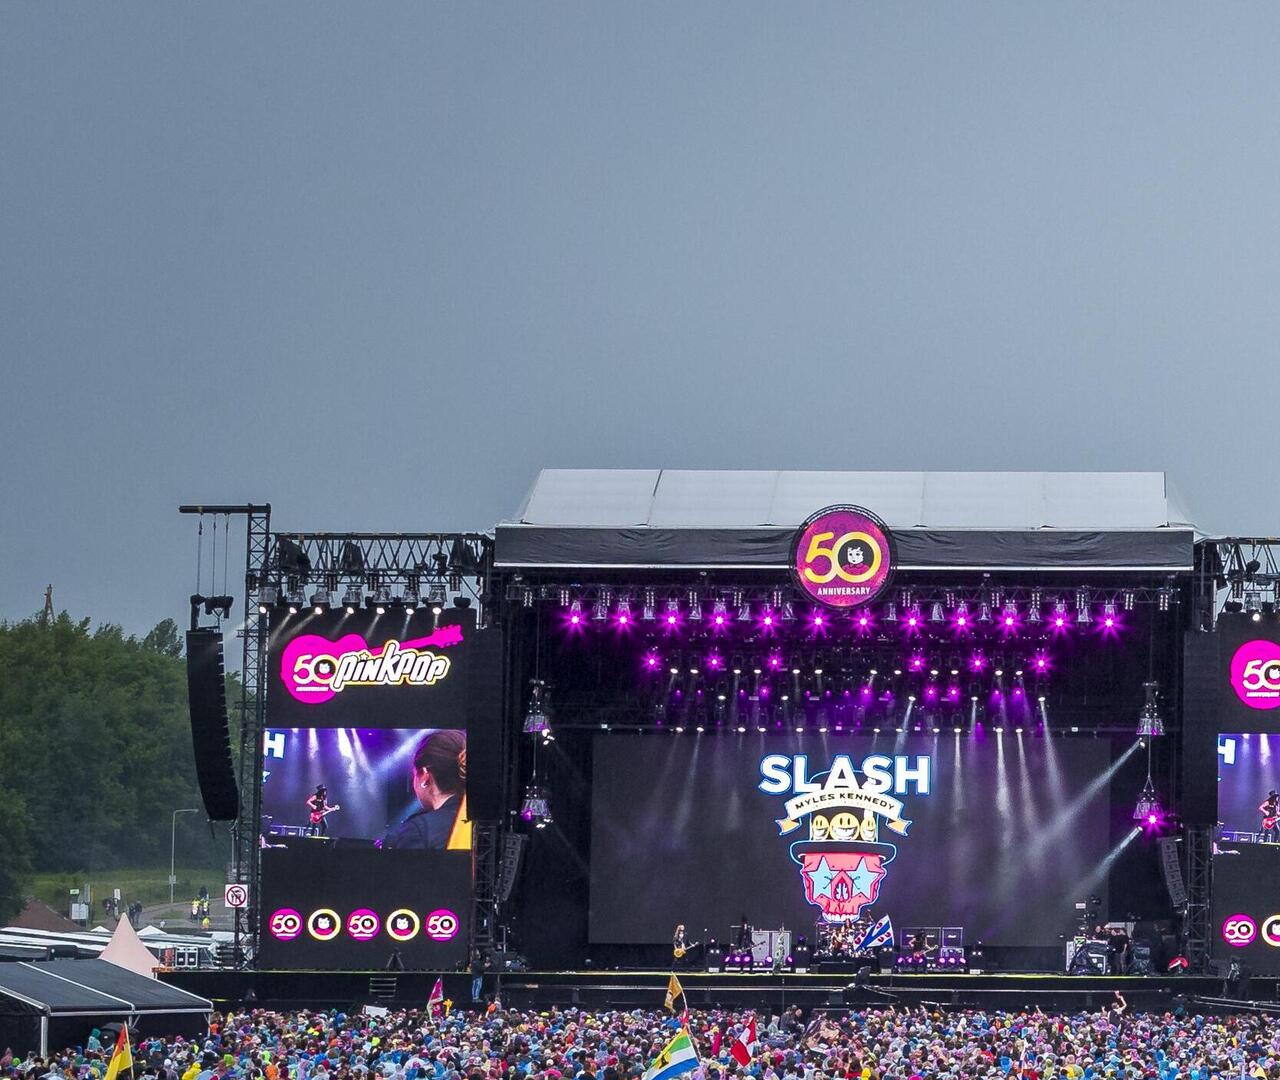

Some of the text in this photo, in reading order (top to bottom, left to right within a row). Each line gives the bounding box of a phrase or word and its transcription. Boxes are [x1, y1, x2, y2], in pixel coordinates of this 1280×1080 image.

[804, 531, 882, 584] 50
[817, 587, 871, 596] ANNIVERSARY
[758, 754, 932, 795] SLASH
[794, 793, 836, 811] MYLES
[839, 792, 896, 811] KENNEDY
